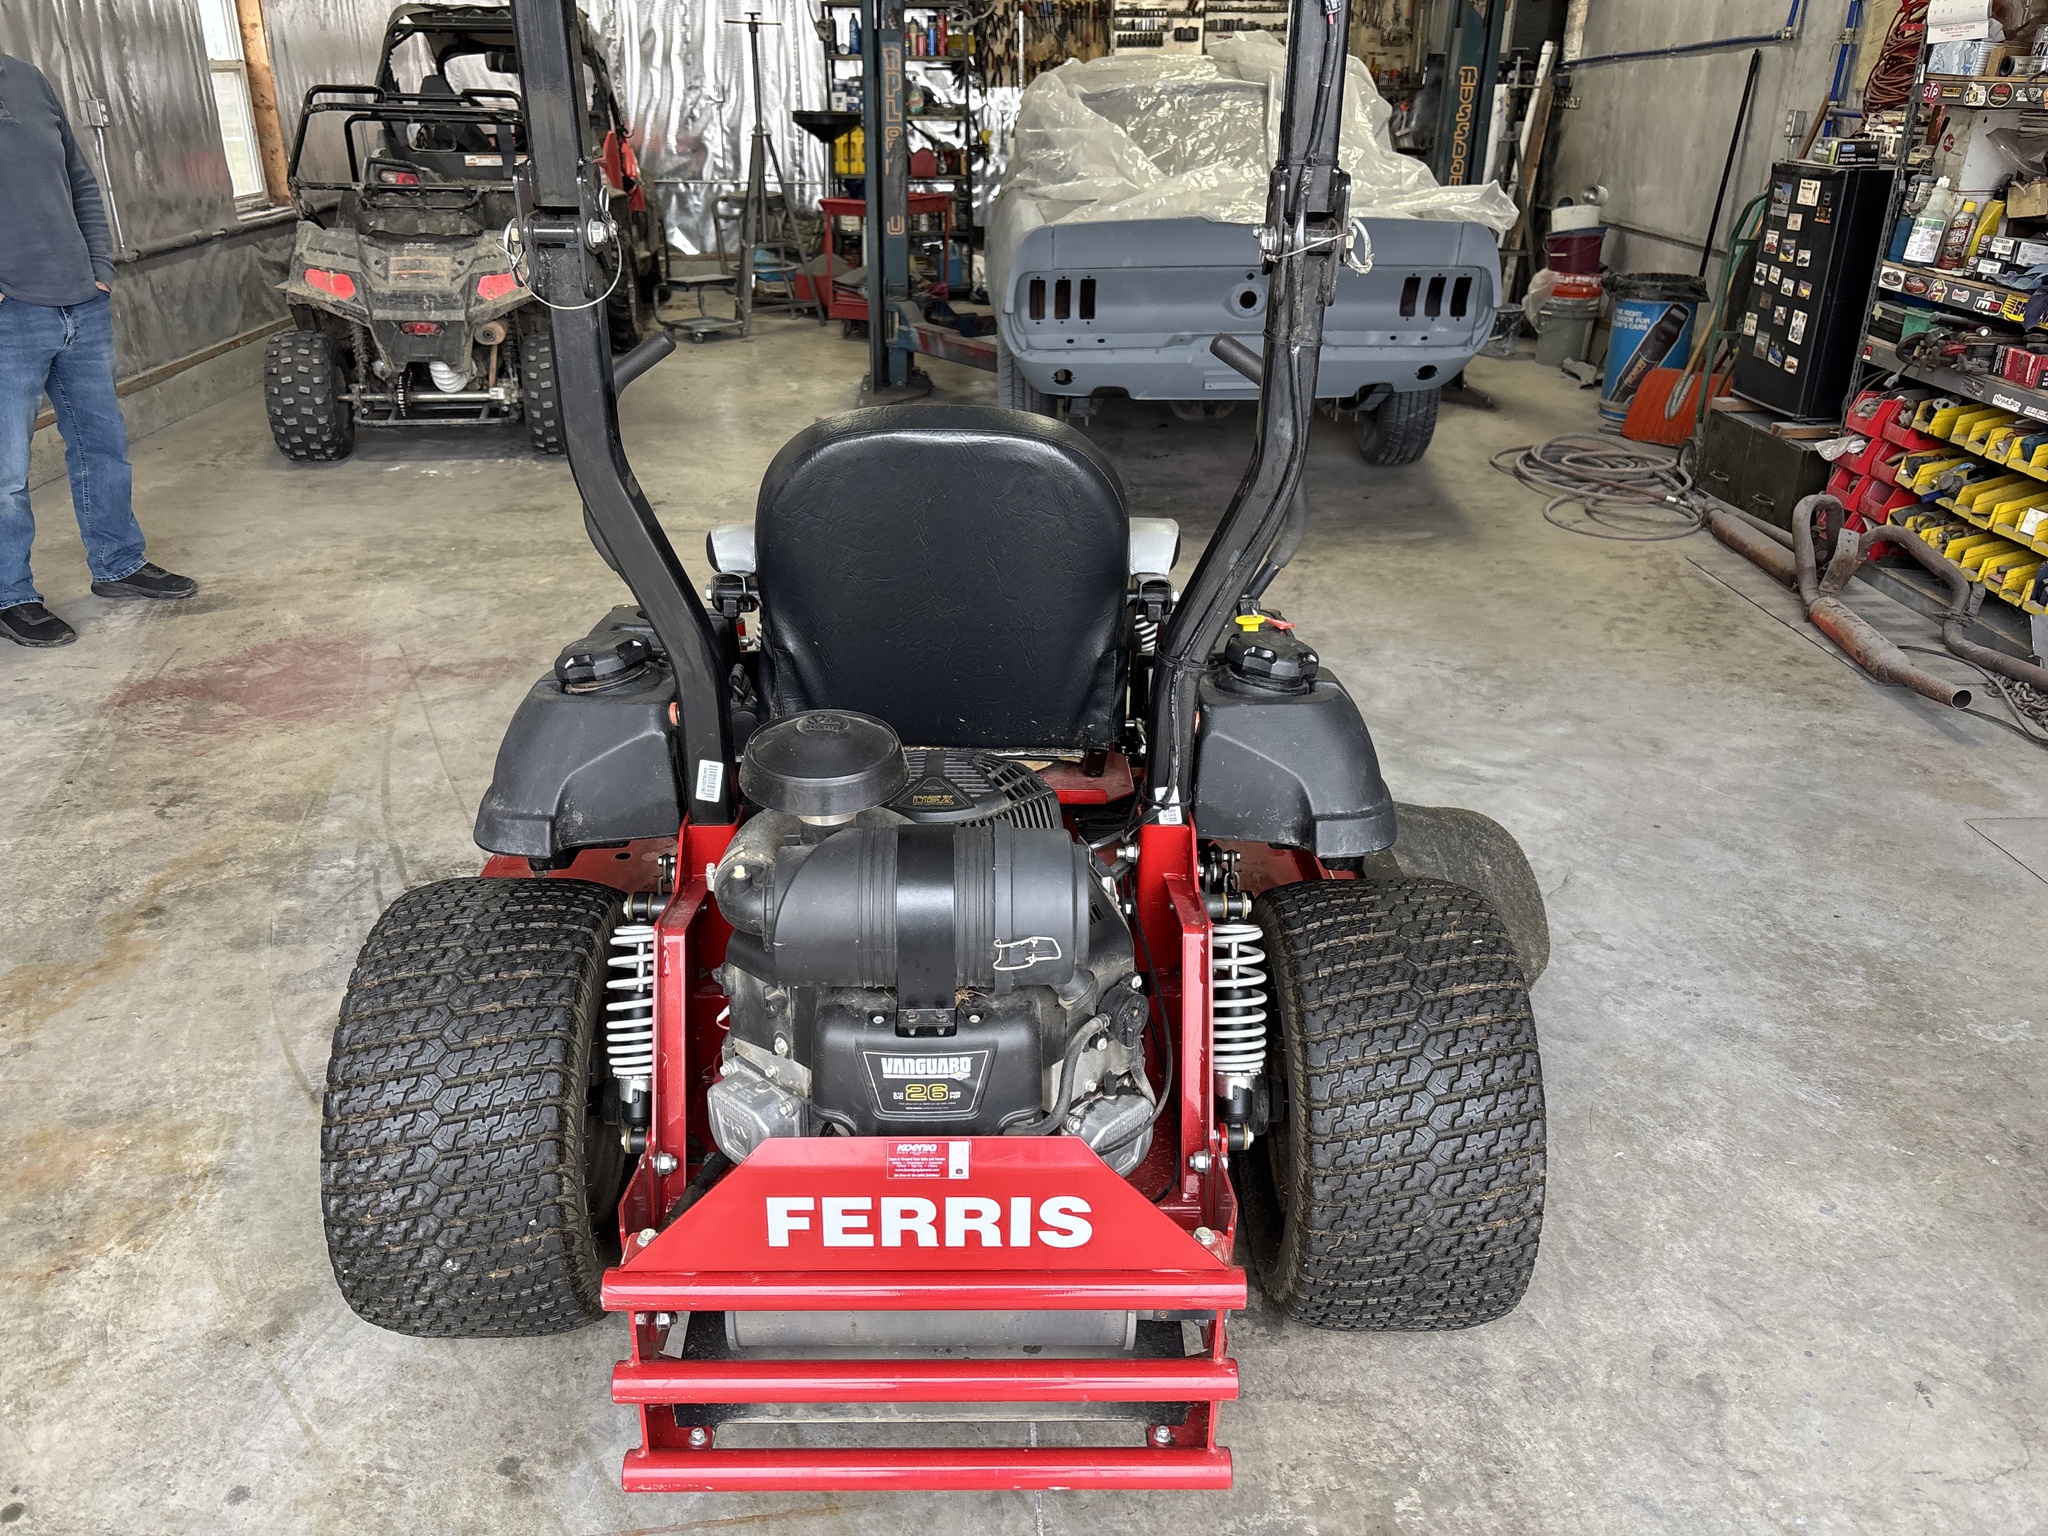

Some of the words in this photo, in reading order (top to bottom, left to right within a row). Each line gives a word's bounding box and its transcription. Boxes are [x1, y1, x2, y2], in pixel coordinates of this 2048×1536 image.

[1923, 82, 1938, 98] STP
[1944, 138, 1954, 148] AC
[1994, 394, 2020, 409] NAMURA
[880, 1057, 971, 1074] VANGUARD
[905, 1083, 949, 1101] 26
[765, 1196, 1094, 1248] FERRIS
